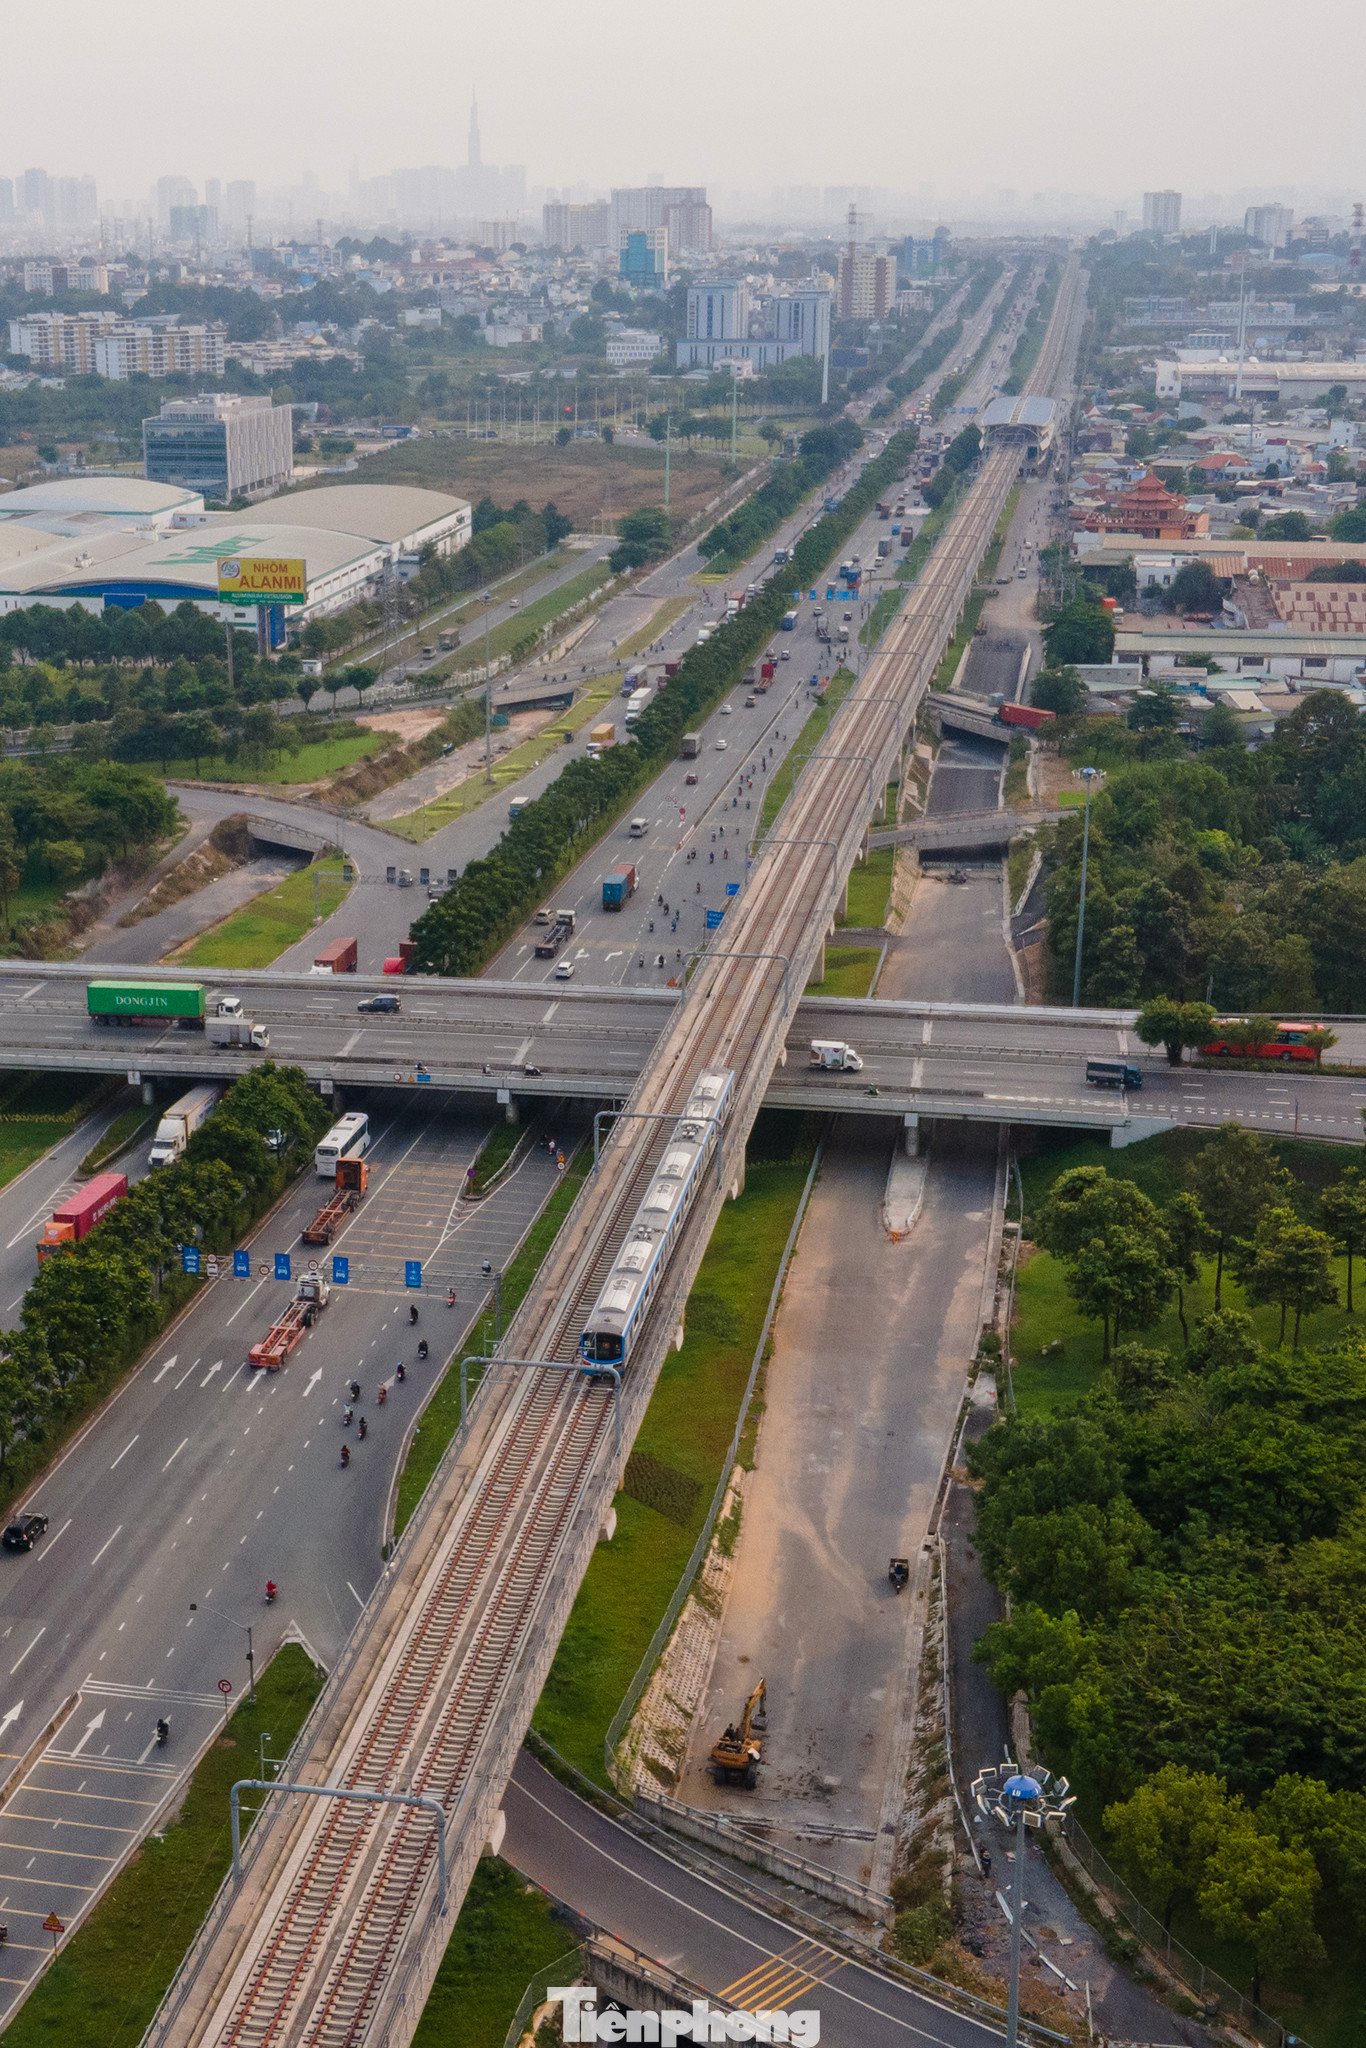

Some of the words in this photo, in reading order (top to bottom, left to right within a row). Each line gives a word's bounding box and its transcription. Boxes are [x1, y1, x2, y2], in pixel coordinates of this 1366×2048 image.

[253, 562, 288, 573] NHÔM
[239, 576, 301, 590] ALANMI
[116, 996, 168, 1006] DONGJIN
